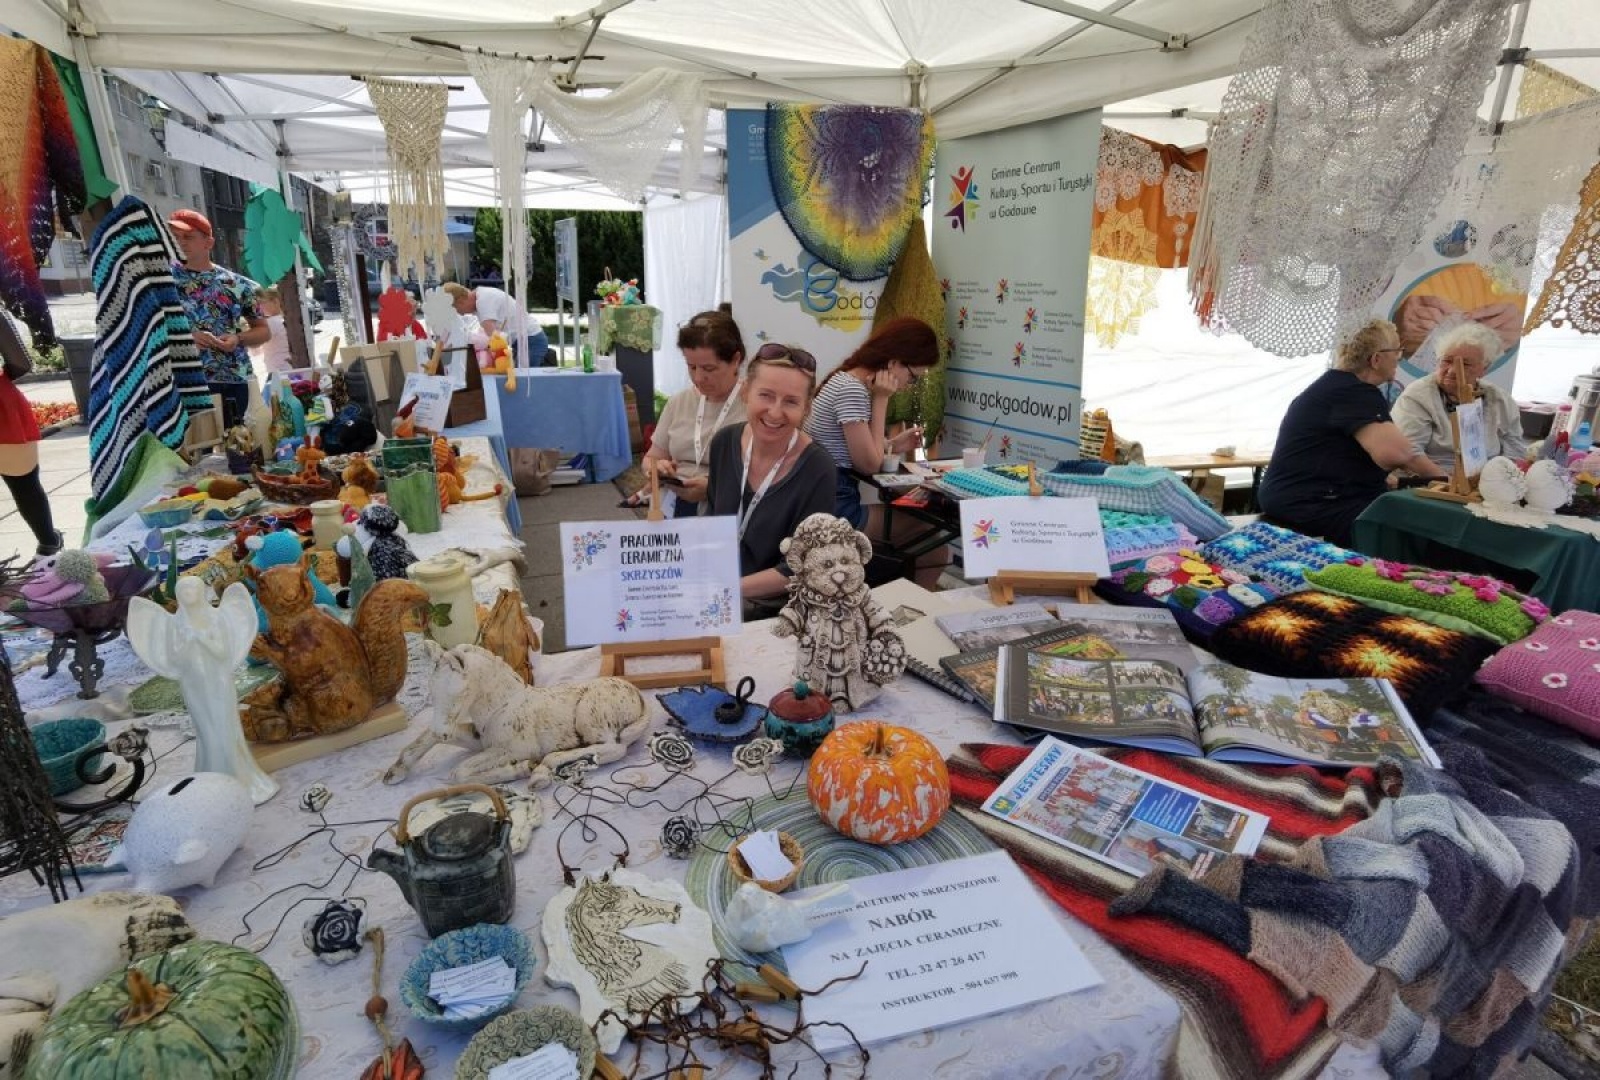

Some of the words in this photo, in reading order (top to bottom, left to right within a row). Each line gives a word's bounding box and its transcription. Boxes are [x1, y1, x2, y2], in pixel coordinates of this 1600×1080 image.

[991, 167, 1021, 181] Gminne
[1023, 160, 1061, 175] Centrum
[1020, 182, 1052, 198] Sportu
[1058, 173, 1093, 193] Turystyki
[989, 211, 997, 219] w
[998, 204, 1037, 218] Godowie
[948, 386, 1072, 426] www.gckgodow.pl
[620, 533, 680, 548] PRACOWNIA
[621, 549, 684, 564] CERAMICZNA
[620, 567, 682, 581] SKRZYSZÓW
[921, 876, 1000, 896] SKRZYSZOWIE
[868, 908, 938, 932] NABÓR
[830, 951, 851, 963] NA
[854, 938, 913, 958] ZAJĘCIA
[916, 919, 1003, 945] CERAMICZNE
[885, 968, 918, 981] TEL.
[918, 963, 933, 975] 32
[935, 959, 948, 969] 47
[950, 956, 965, 966] 26
[967, 951, 986, 962] 417
[881, 985, 957, 1010] INSTRUKTOR
[983, 975, 1000, 985] 637
